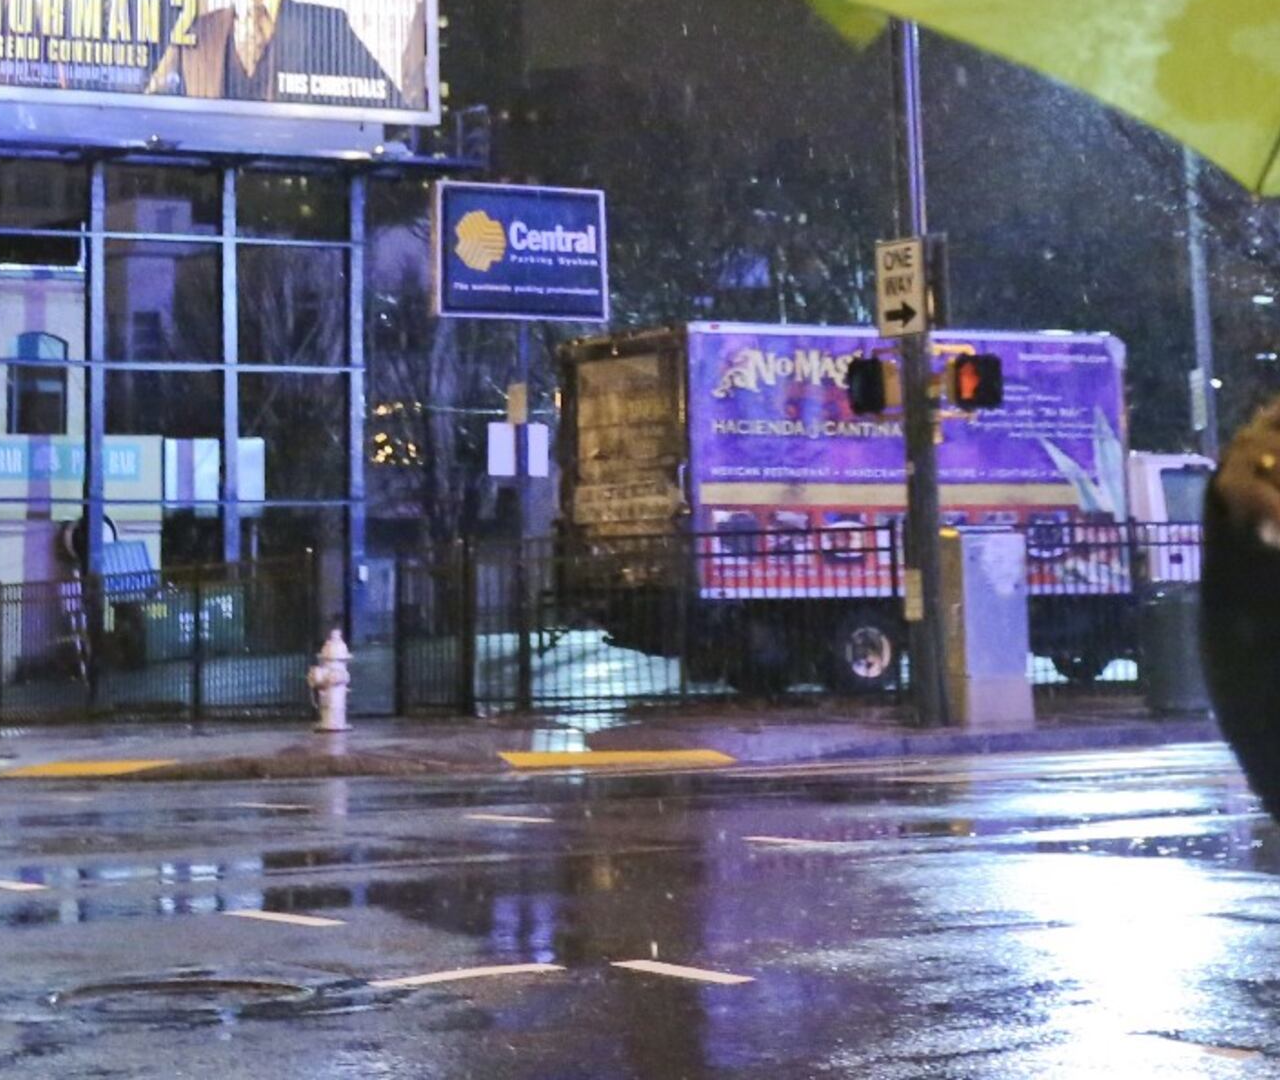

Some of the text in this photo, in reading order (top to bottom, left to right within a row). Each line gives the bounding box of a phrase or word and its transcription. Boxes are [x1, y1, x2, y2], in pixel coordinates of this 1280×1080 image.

[47, 36, 149, 67] CONTINUES
[277, 72, 387, 100] THIS CHRISTMAS
[509, 220, 596, 254] Central
[509, 254, 599, 267] Parking System
[883, 246, 913, 271] ONE
[883, 273, 914, 297] WAY
[713, 420, 806, 437] HACIENDA
[823, 421, 904, 437] CANTINA
